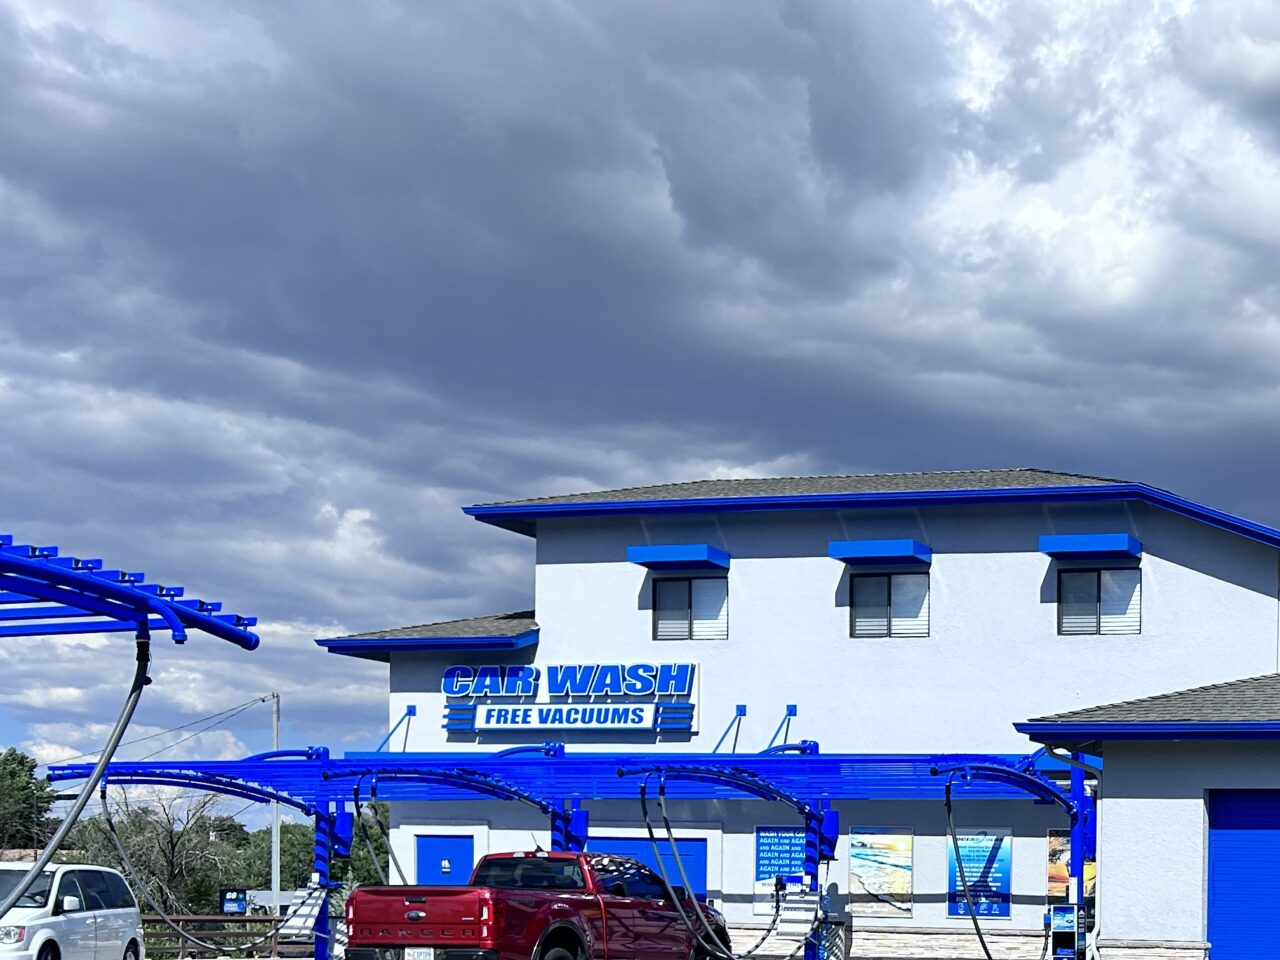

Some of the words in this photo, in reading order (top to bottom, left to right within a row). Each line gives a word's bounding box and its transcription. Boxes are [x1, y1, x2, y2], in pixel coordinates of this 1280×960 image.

[441, 665, 536, 697] CAR
[546, 663, 692, 695] WASH
[485, 708, 532, 724] FREE
[538, 707, 645, 724] VACUUMS
[360, 928, 476, 937] RANGER
